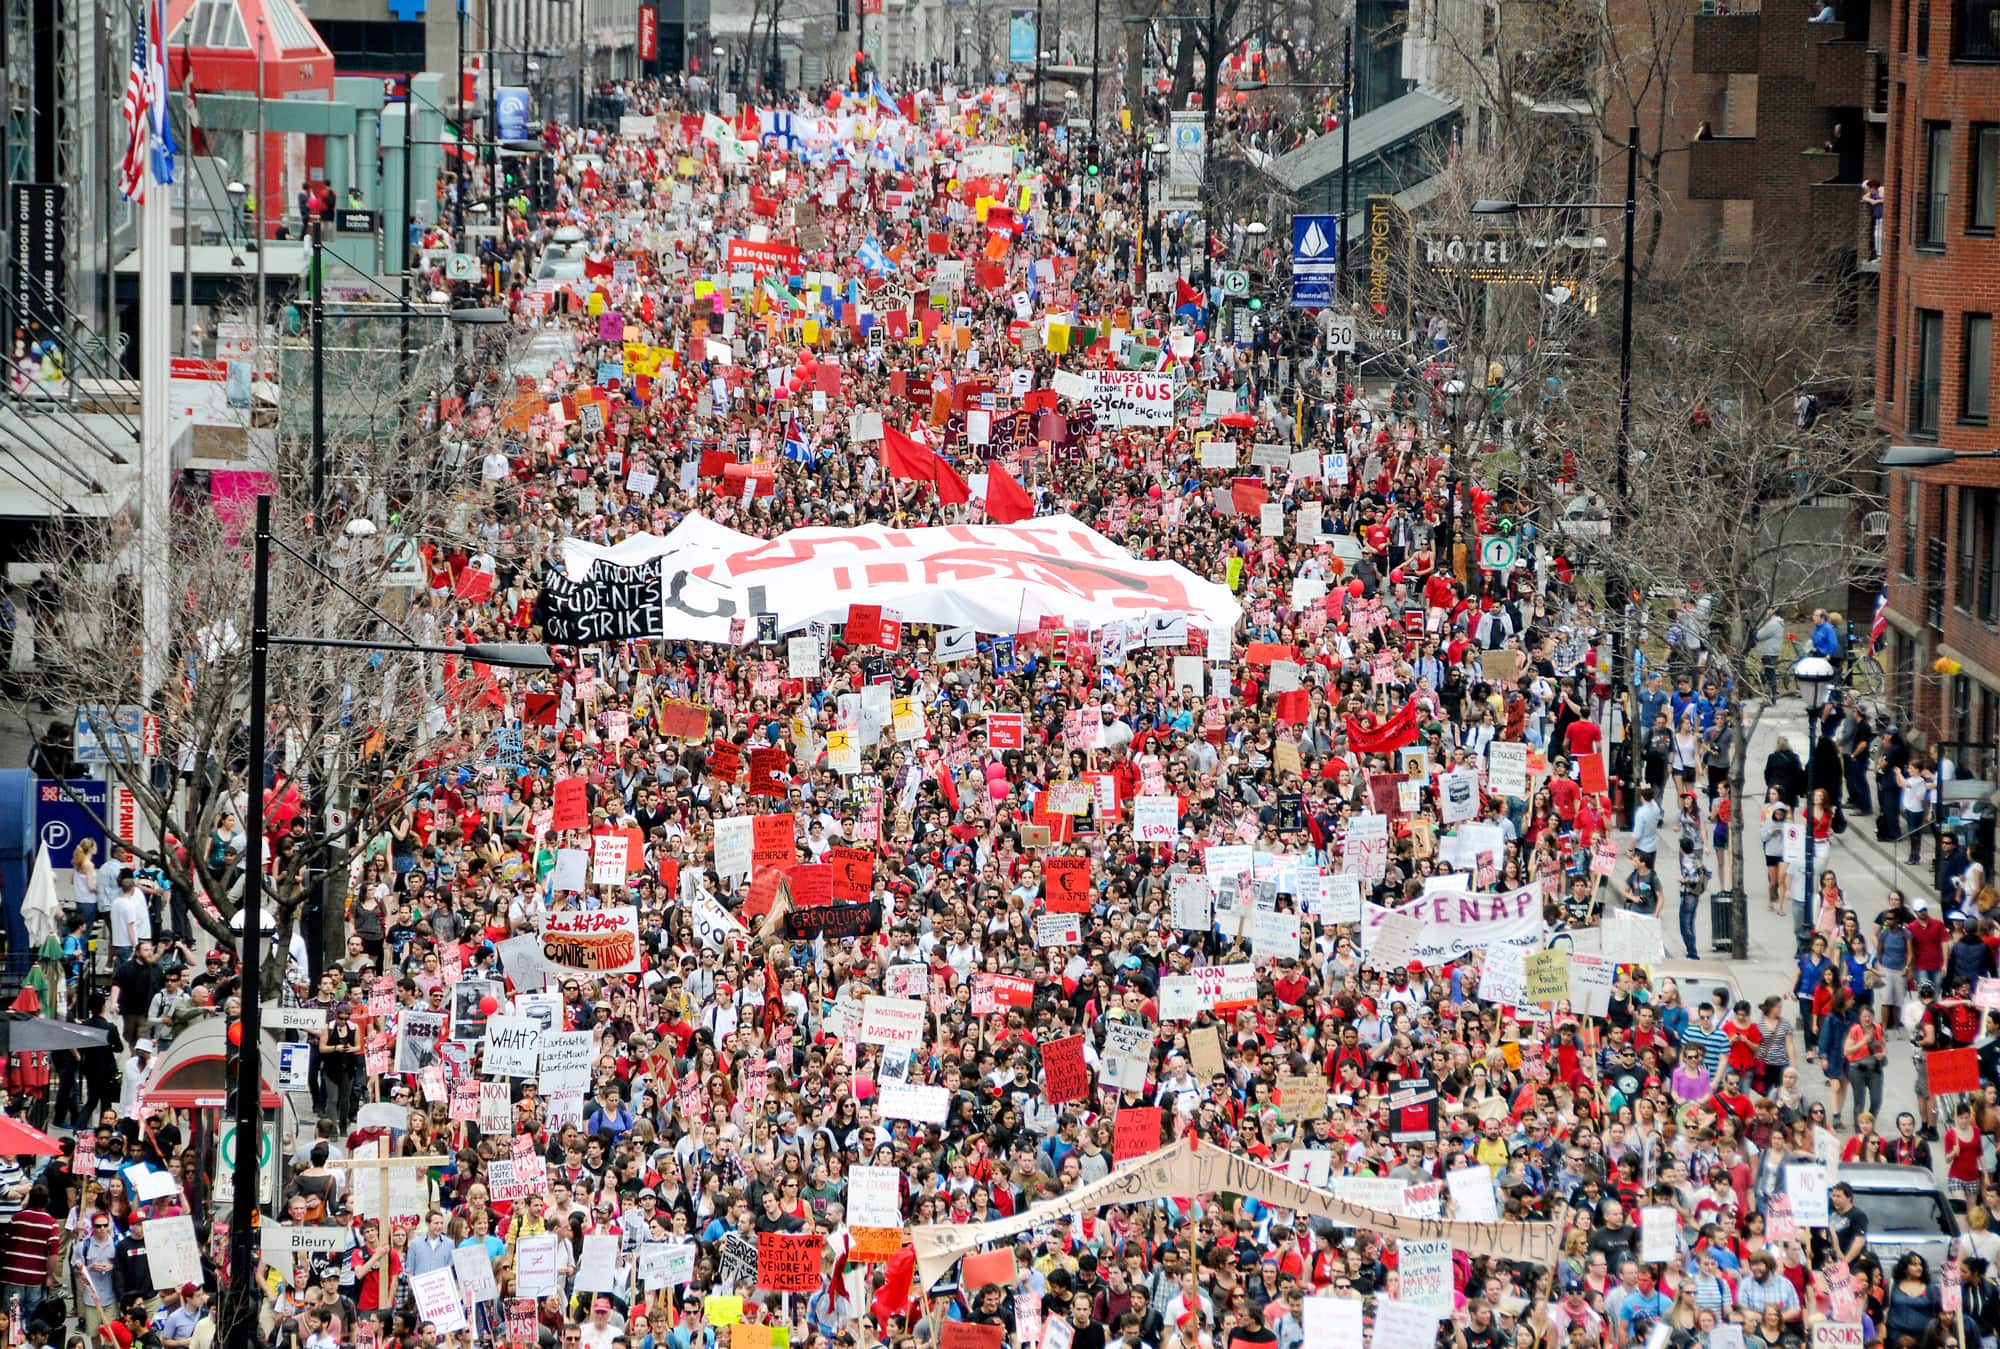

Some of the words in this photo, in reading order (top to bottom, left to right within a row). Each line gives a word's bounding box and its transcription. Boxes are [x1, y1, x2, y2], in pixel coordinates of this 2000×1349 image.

[20, 189, 29, 221] OUEST
[1427, 236, 1509, 263] HÔTEL
[1331, 327, 1352, 345] 50
[1100, 371, 1143, 384] HAUSSE
[1125, 384, 1171, 400] FOUS
[1328, 455, 1343, 468] NO
[545, 560, 662, 594] INTENATIONAL
[547, 616, 568, 639] ON
[577, 604, 663, 640] STRIKE
[544, 943, 588, 968] CONTRE
[587, 951, 596, 960] LA
[596, 942, 634, 969] HAUSSE
[1193, 967, 1225, 979] NON
[283, 1014, 317, 1026] Bleury
[484, 1084, 508, 1099] NON
[481, 1115, 510, 1131] HAUSSE
[1403, 1184, 1437, 1205] NON
[291, 1235, 336, 1249] Bleury
[760, 1236, 774, 1248] LE
[782, 1236, 821, 1249] SAVOIR
[1403, 1242, 1448, 1256] SAVOIR
[760, 1262, 799, 1273] VENDRE
[1404, 1267, 1424, 1277] AVEC
[1427, 1265, 1441, 1273] UNE
[774, 1274, 820, 1286] ACHETER
[1403, 1276, 1441, 1287] HAUSSE
[426, 1303, 456, 1319] HIKE!
[511, 1318, 531, 1336] PAS
